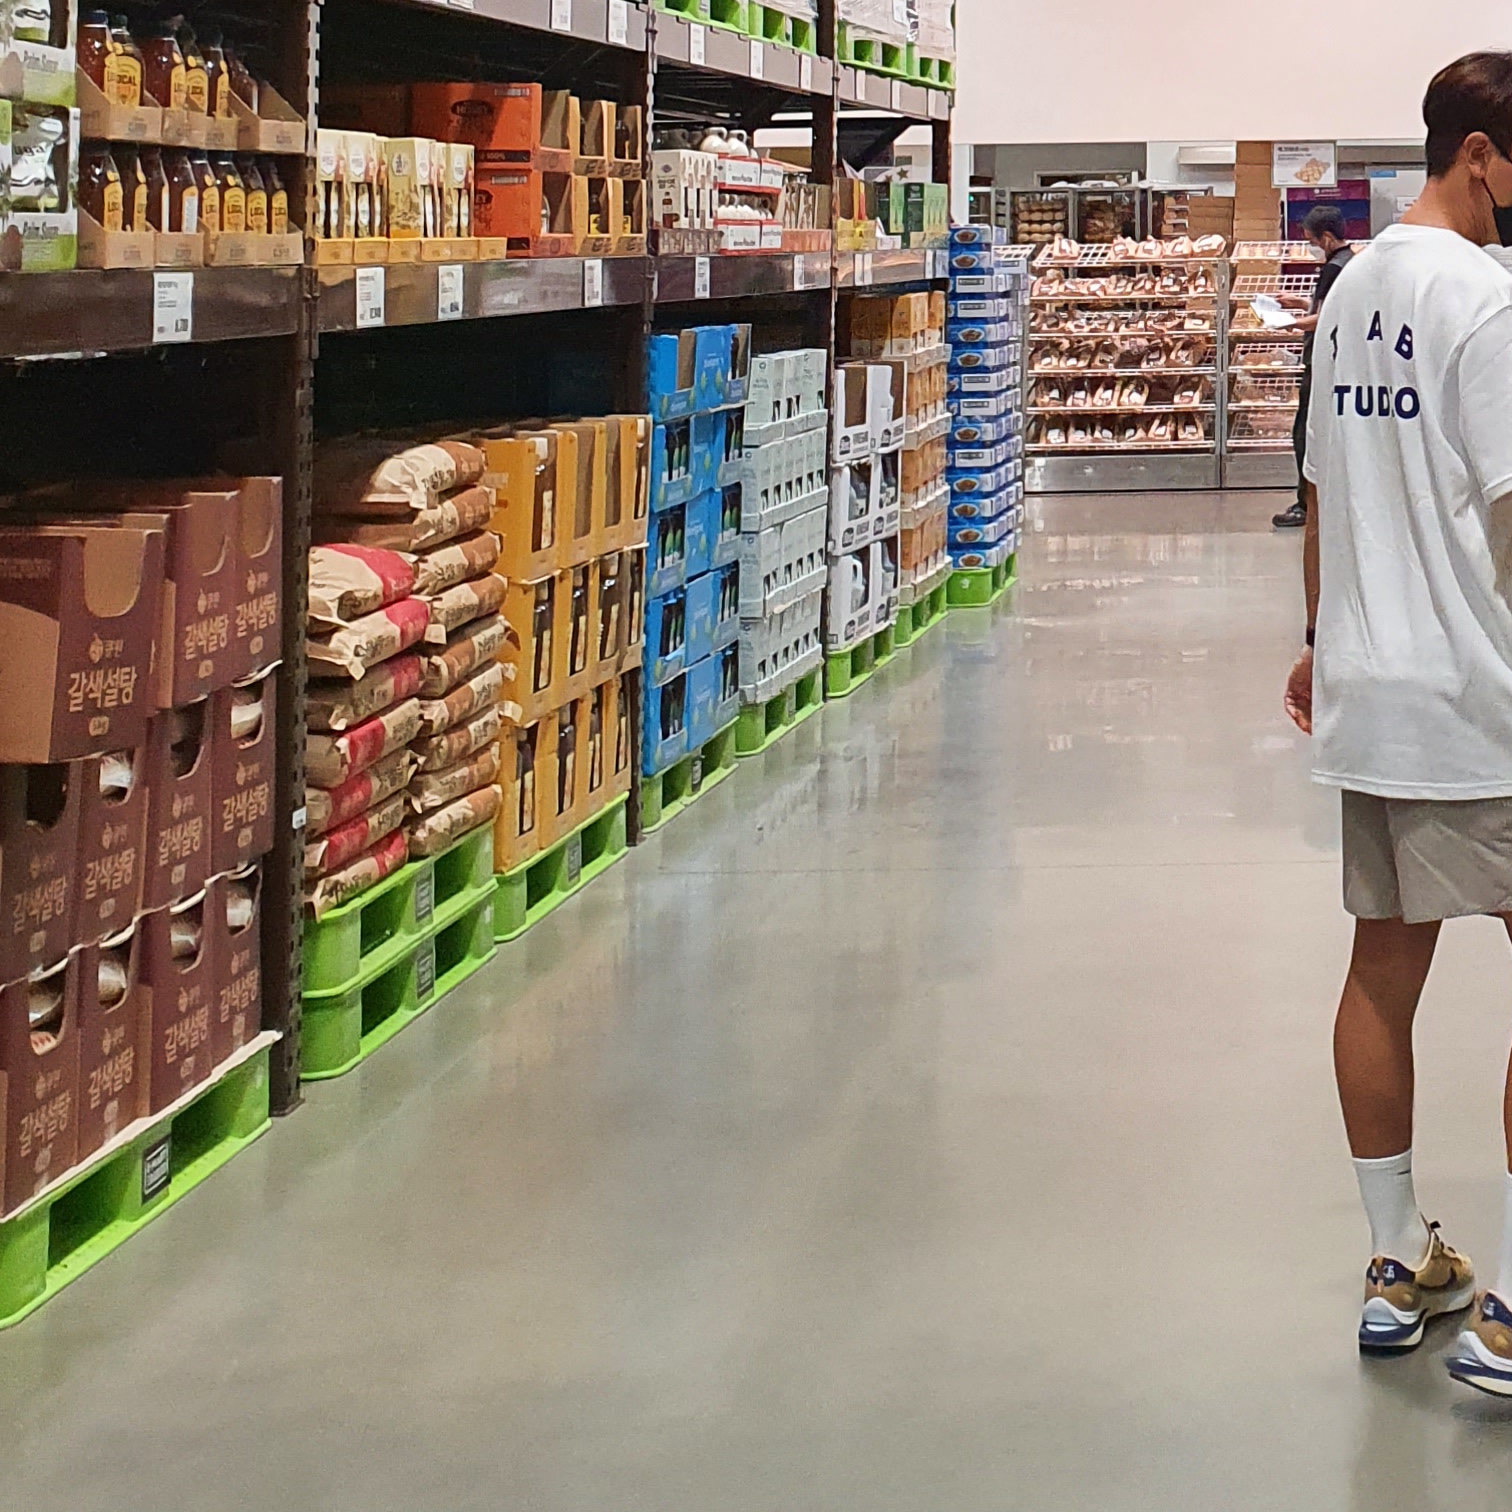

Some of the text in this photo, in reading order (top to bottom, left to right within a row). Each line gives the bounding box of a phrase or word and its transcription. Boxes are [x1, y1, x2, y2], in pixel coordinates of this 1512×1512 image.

[185, 614, 229, 660] 갈색설탕
[235, 592, 278, 638] 갈색설탕
[68, 665, 138, 713] 갈색설탕
[222, 781, 270, 832] 갈색설탕
[158, 816, 202, 866] 갈색설탕
[86, 847, 136, 900] 갈색설탕
[89, 1044, 135, 1109] 갈색설탕
[19, 1089, 72, 1157] 갈색설탕
